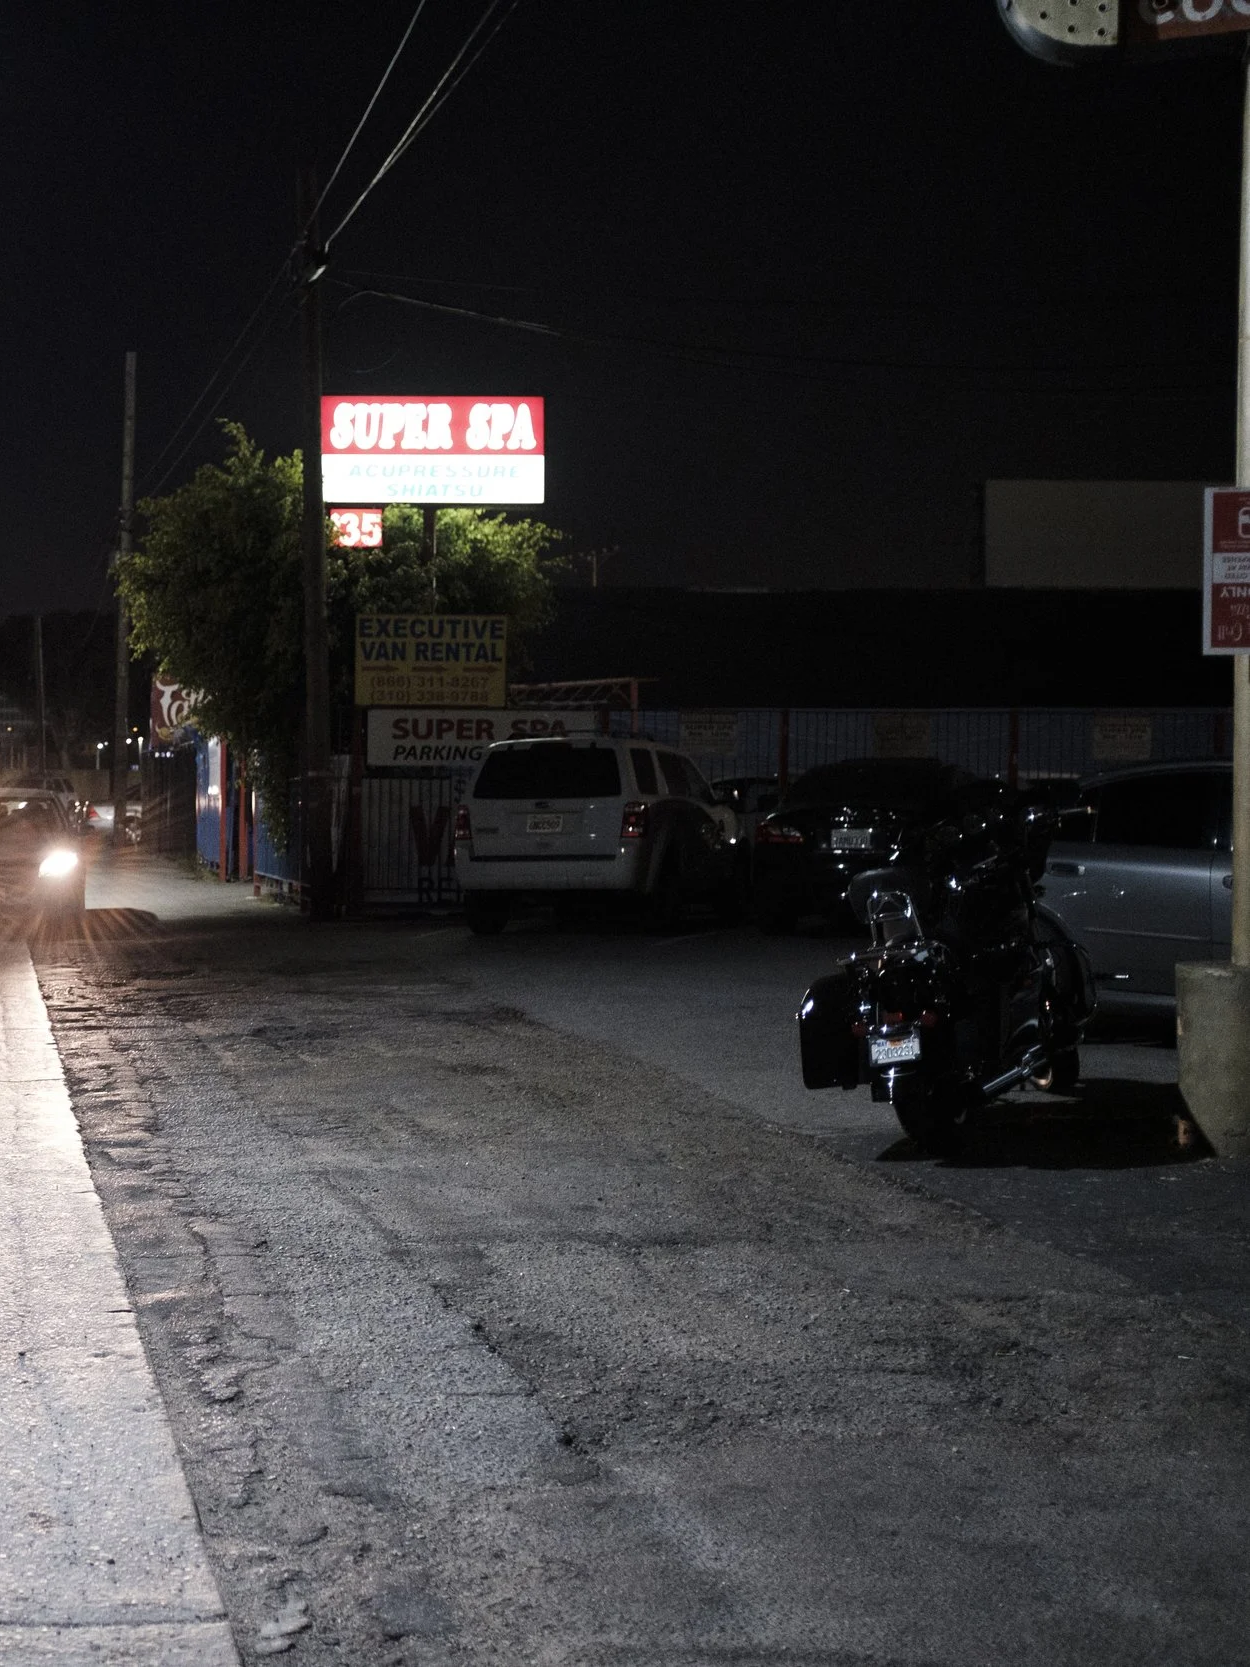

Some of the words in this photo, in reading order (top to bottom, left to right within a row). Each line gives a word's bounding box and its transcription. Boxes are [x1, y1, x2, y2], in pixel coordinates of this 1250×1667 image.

[330, 402, 453, 450] SUPER
[465, 402, 537, 450] SPA
[349, 464, 520, 478] ACUPRESSURE
[387, 483, 483, 497] SHIATSU
[1219, 586, 1250, 598] NLY
[358, 618, 504, 639] EXECUTIVE
[360, 641, 407, 661] VAN
[415, 642, 503, 662] RENTAL
[392, 718, 494, 740] SUPER
[511, 719, 567, 738] SPA
[393, 745, 482, 761] PARKING
